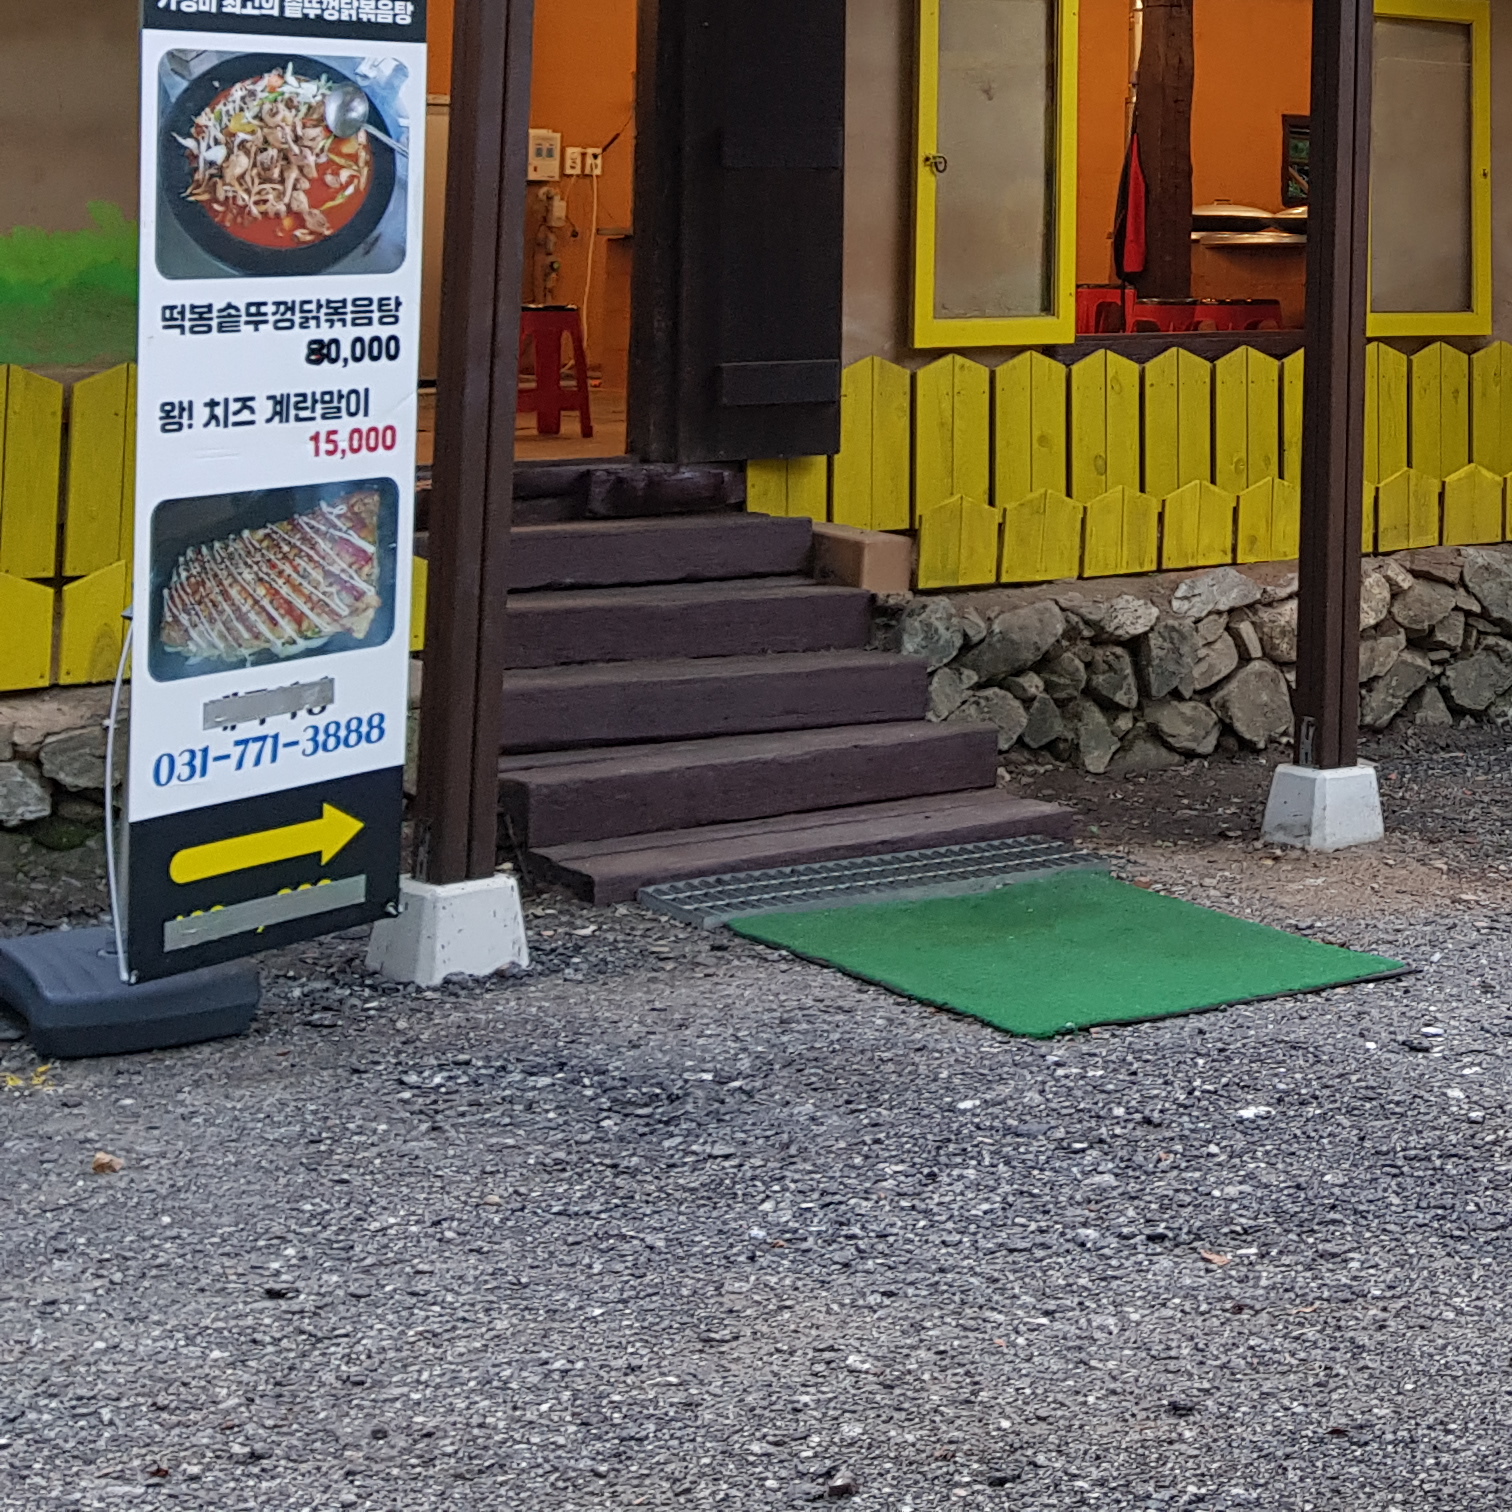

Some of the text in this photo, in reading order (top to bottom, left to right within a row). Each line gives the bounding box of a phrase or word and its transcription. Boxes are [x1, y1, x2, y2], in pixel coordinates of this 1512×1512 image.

[161, 296, 402, 335] 떡봉솥뚜껑닭볶음탕
[159, 388, 370, 433] 왕! 치즈 계란말이
[309, 425, 397, 459] 15,000
[153, 713, 386, 786] 031-771-3888
